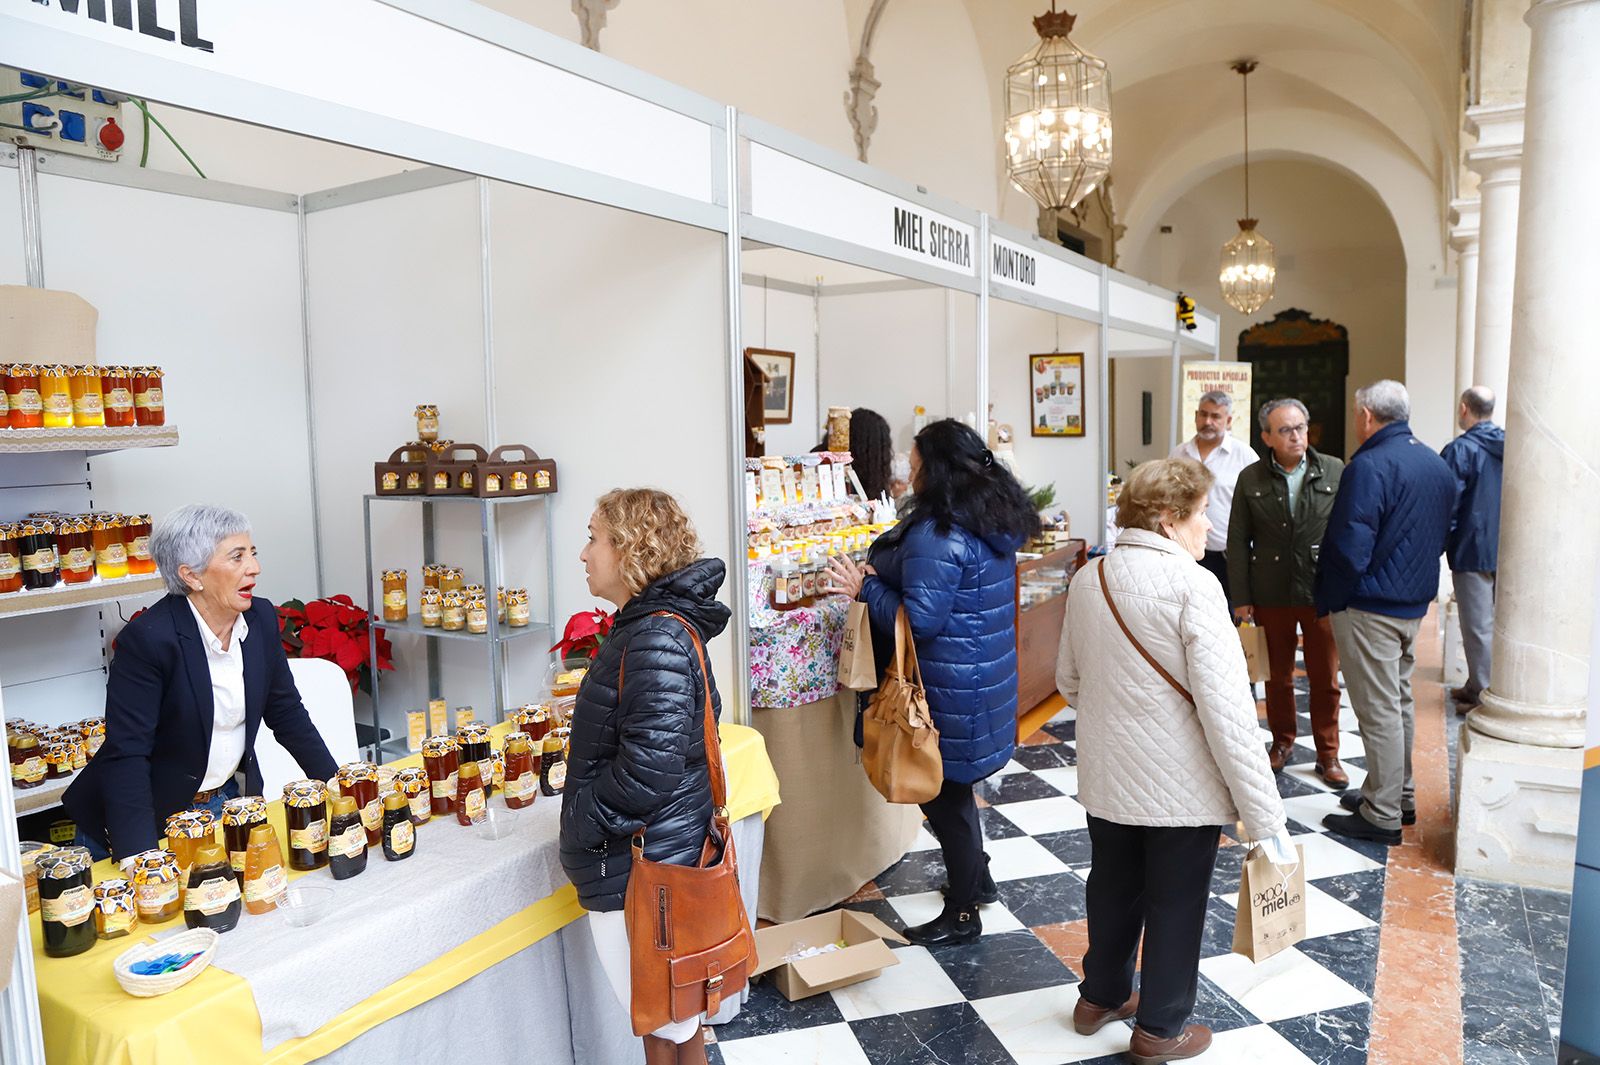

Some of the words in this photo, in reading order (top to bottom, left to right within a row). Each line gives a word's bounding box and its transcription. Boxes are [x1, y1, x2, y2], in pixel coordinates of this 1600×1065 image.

[894, 206, 925, 254] MIEL
[929, 220, 971, 268] SIERRA
[993, 243, 1036, 286] MONTORO
[1187, 370, 1220, 381] PRODUCTOS
[1262, 891, 1288, 917] miel
